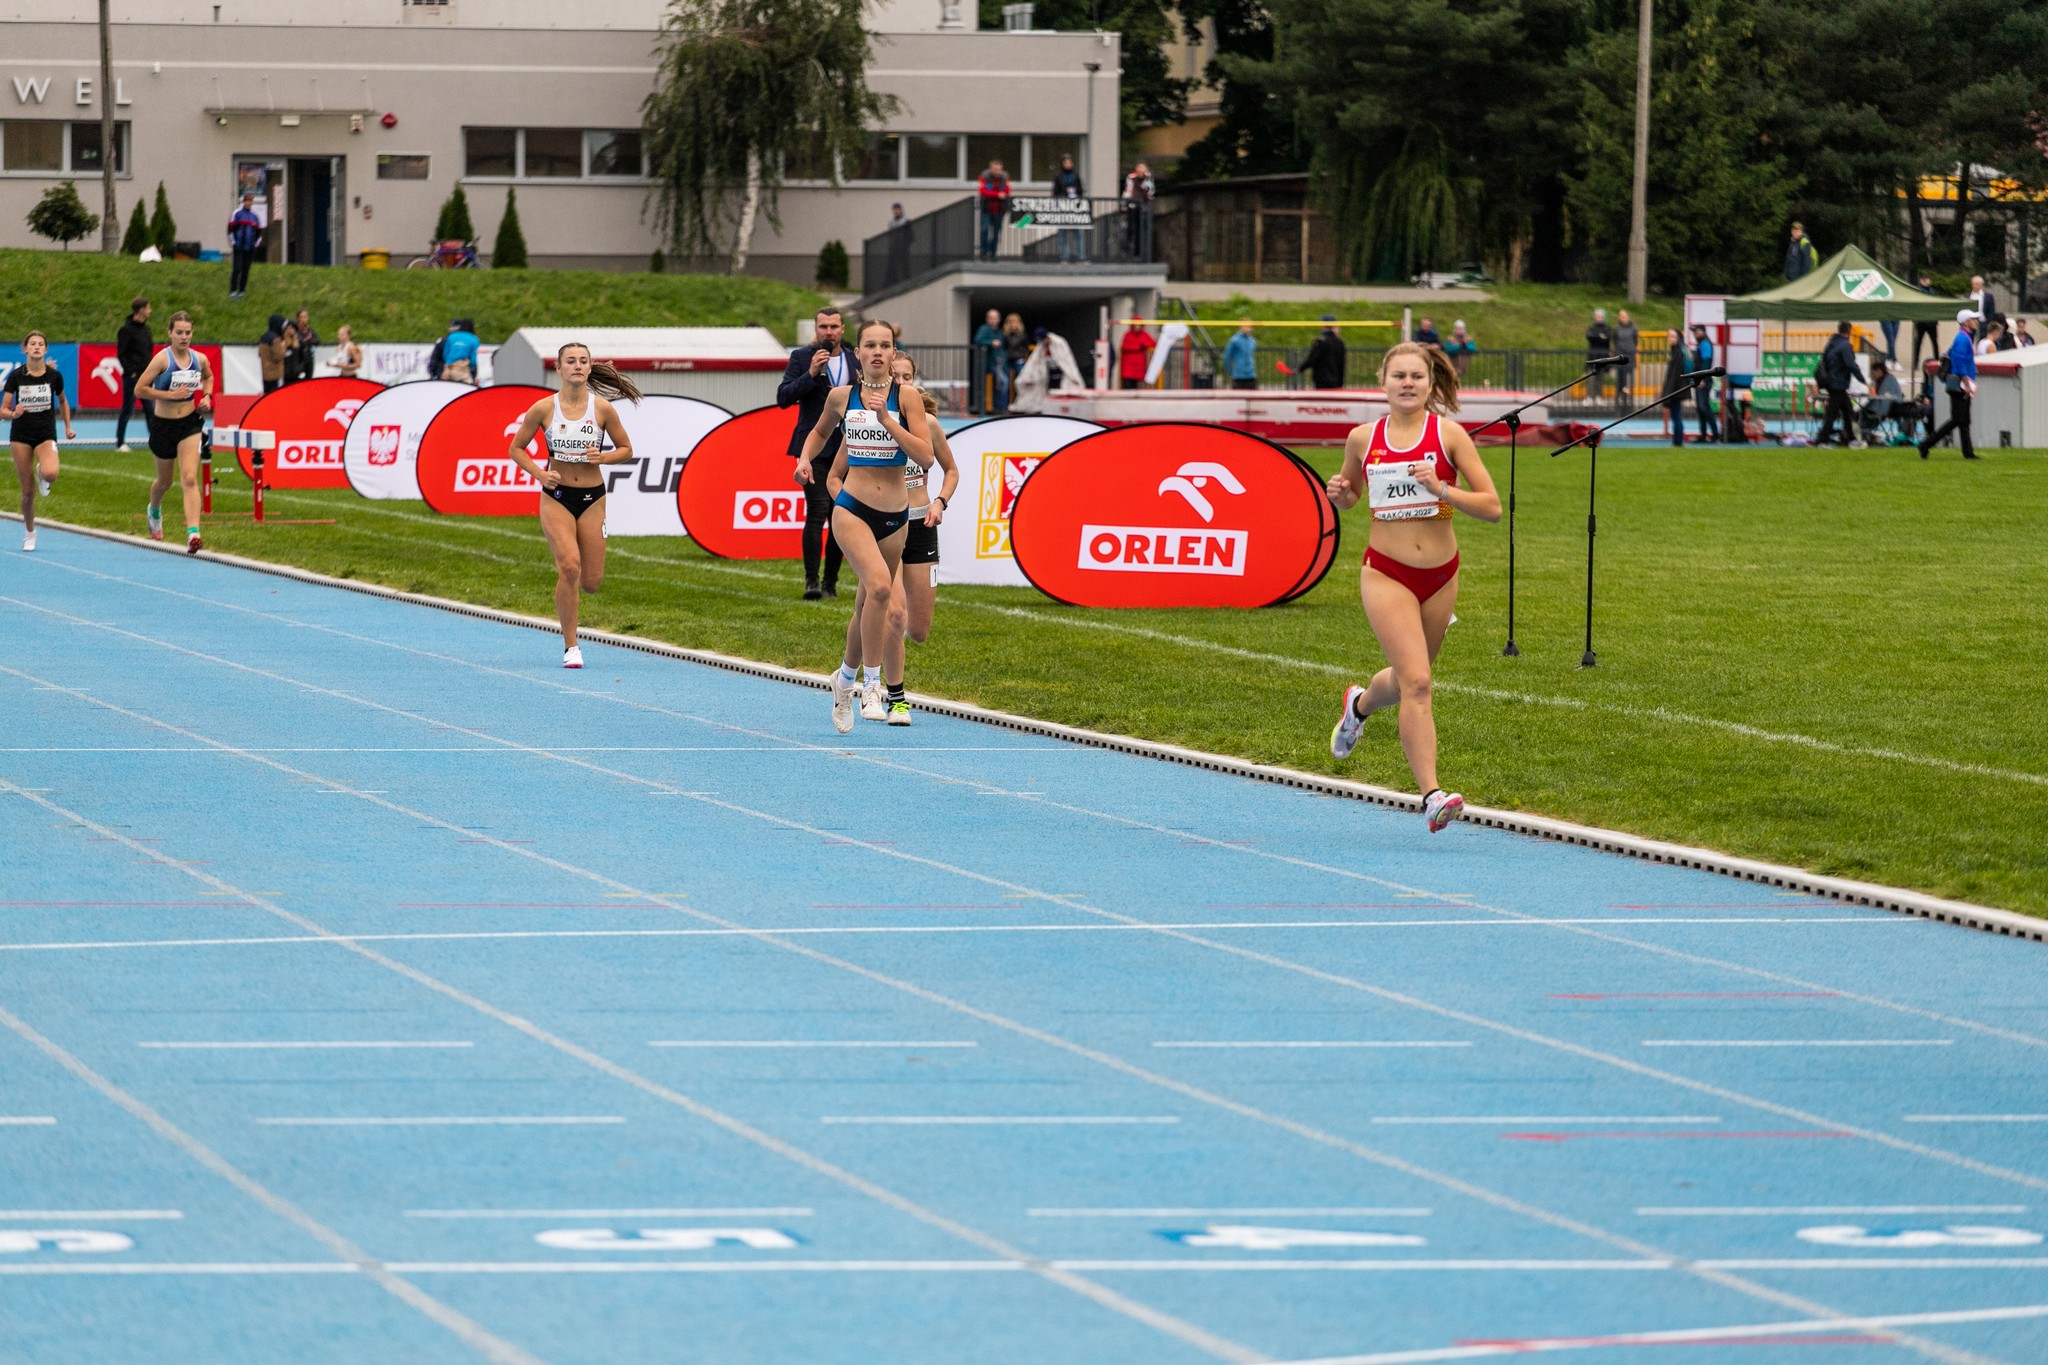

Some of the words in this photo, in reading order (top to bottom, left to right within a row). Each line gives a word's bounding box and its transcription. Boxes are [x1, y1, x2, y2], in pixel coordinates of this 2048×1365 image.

[1012, 198, 1091, 213] STRZELNICA
[580, 425, 594, 434] 40
[1387, 484, 1417, 498] ŻUK
[1089, 532, 1236, 568] ORLEN
